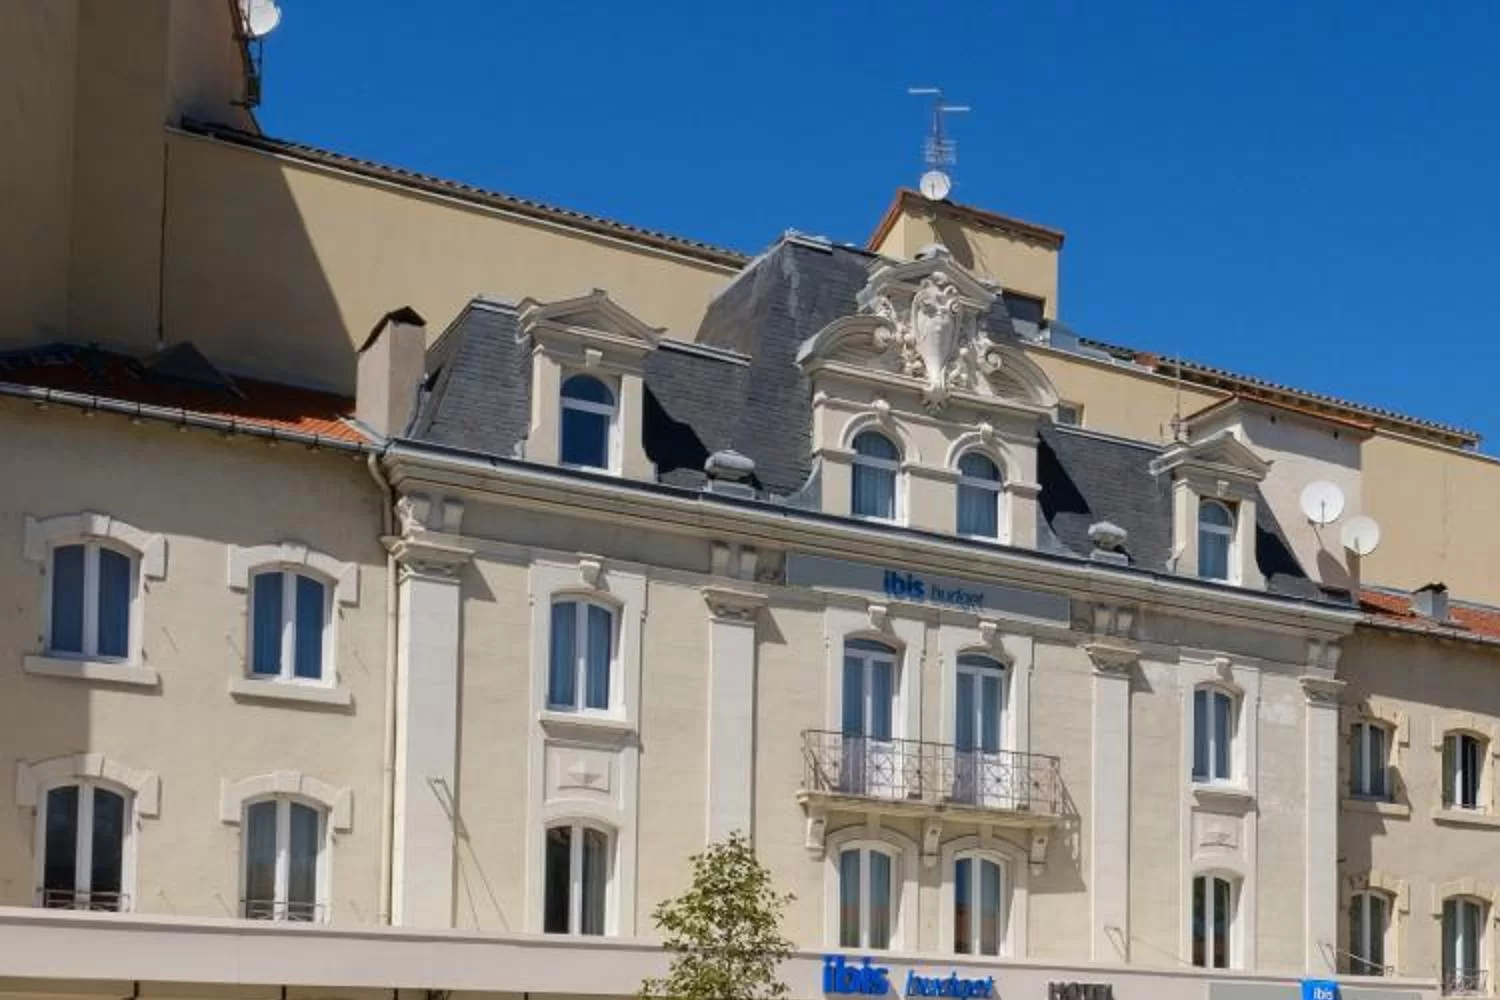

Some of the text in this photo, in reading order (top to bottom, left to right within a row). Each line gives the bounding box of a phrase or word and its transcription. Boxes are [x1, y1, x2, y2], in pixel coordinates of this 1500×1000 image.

[883, 569, 926, 599] ibis
[823, 954, 889, 995] ibis
[1312, 986, 1335, 1000] ibis
